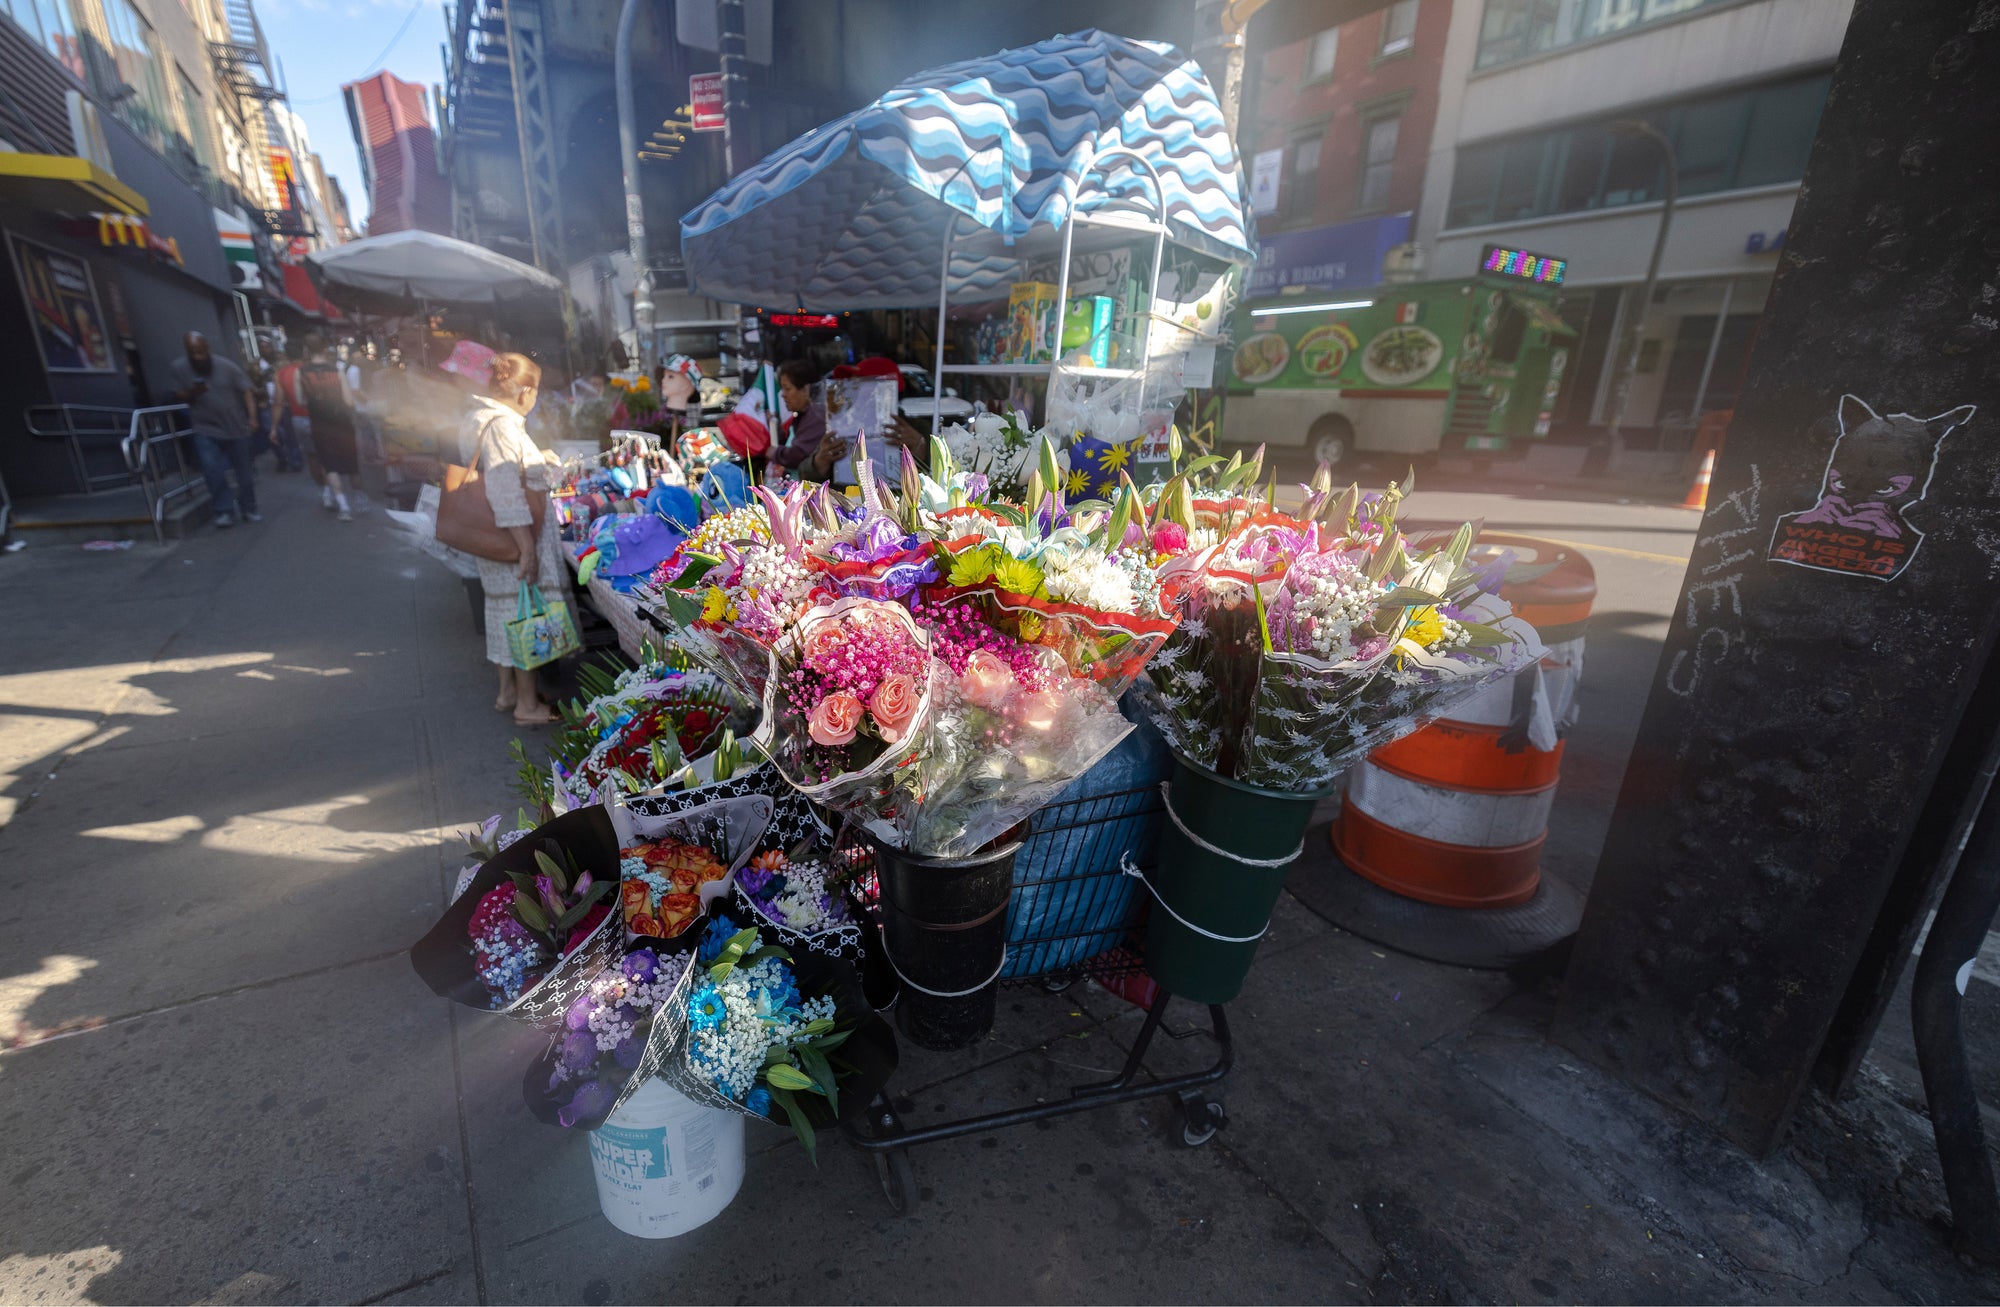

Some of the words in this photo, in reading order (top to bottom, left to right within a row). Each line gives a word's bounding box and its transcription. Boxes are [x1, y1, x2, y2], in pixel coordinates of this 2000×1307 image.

[1778, 538, 1896, 567] ANGELA
[1784, 525, 1867, 547] WHO
[1873, 540, 1905, 555] IS
[590, 1131, 655, 1167] SUPER
